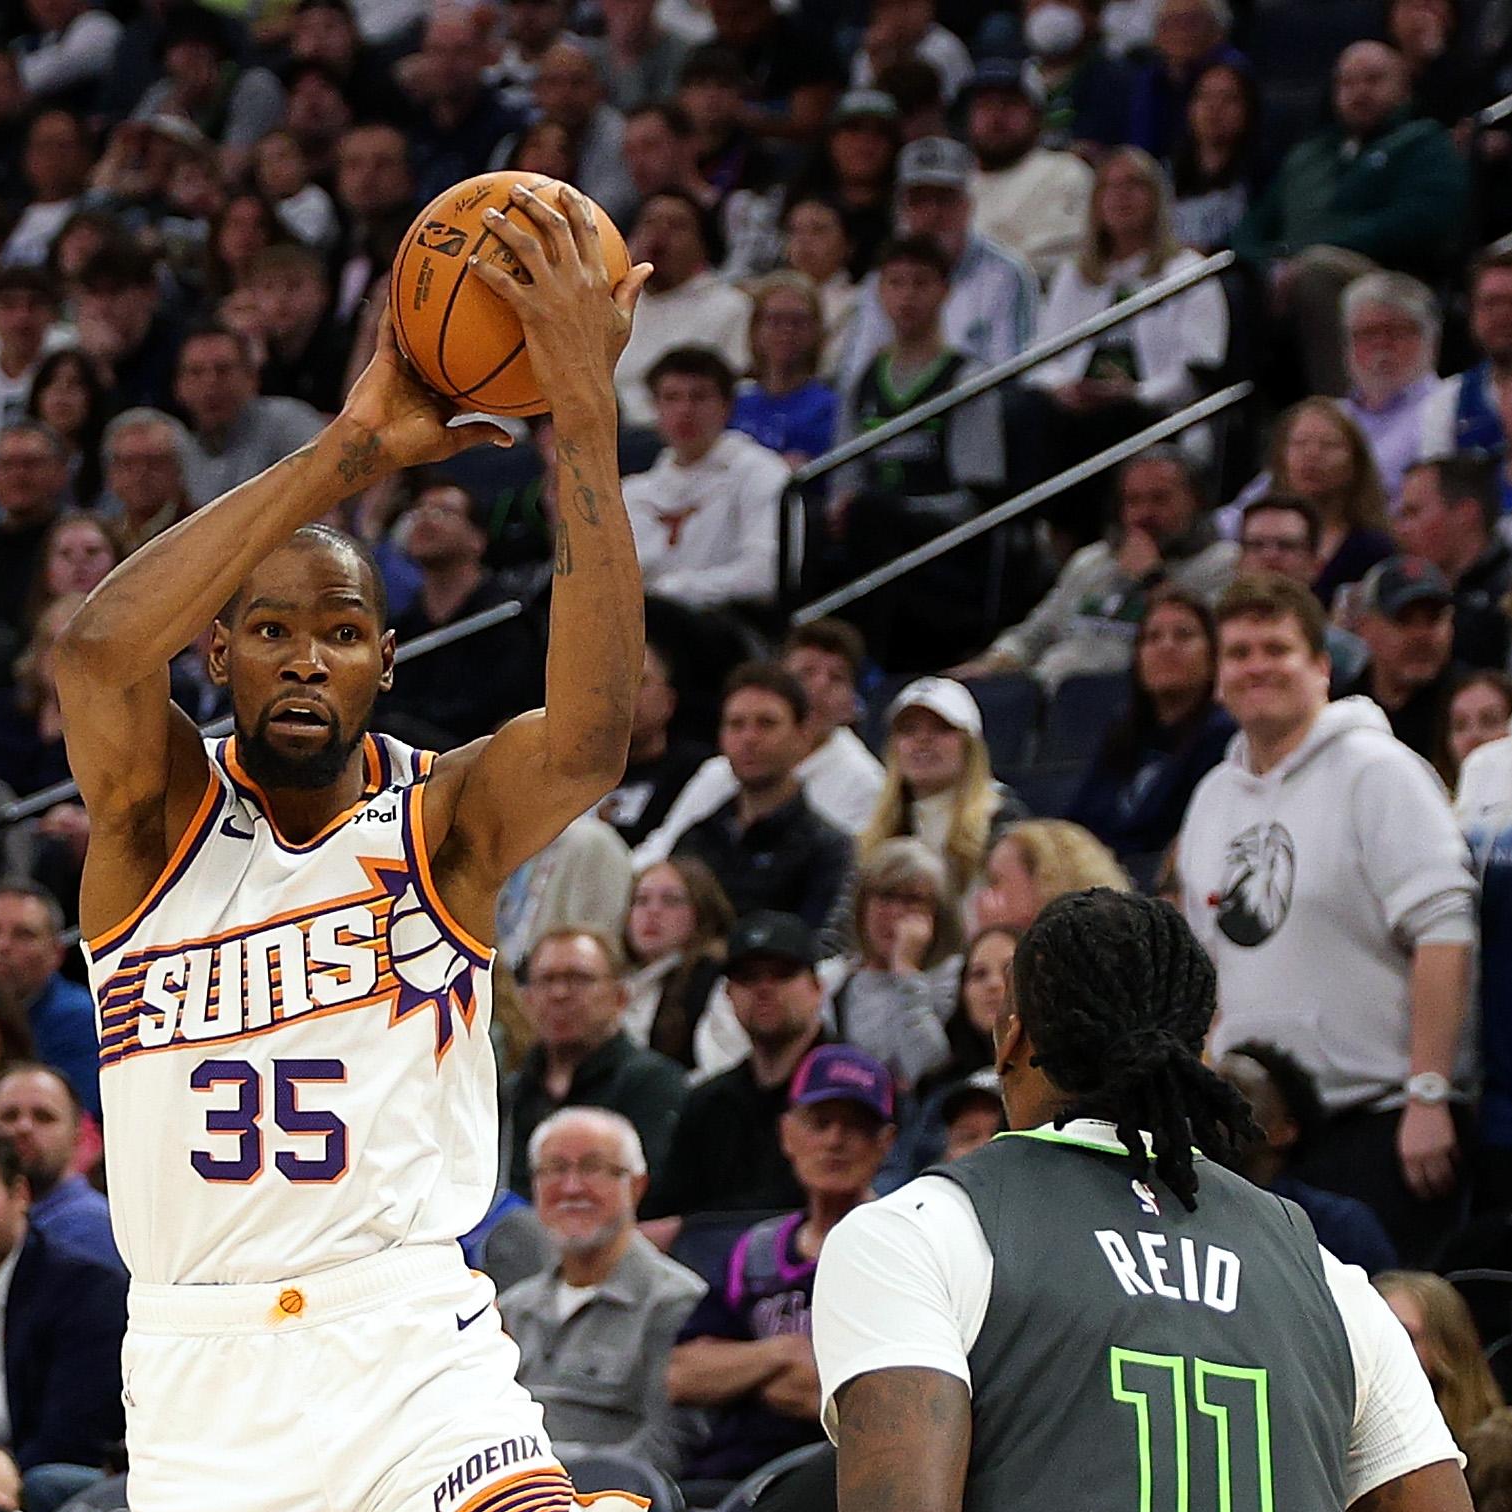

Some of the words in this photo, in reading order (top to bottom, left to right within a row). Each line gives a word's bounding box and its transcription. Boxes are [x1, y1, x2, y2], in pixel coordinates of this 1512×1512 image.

[138, 905, 380, 1048] SUNS
[190, 1058, 349, 1184] 35
[1094, 1230, 1242, 1313] REID
